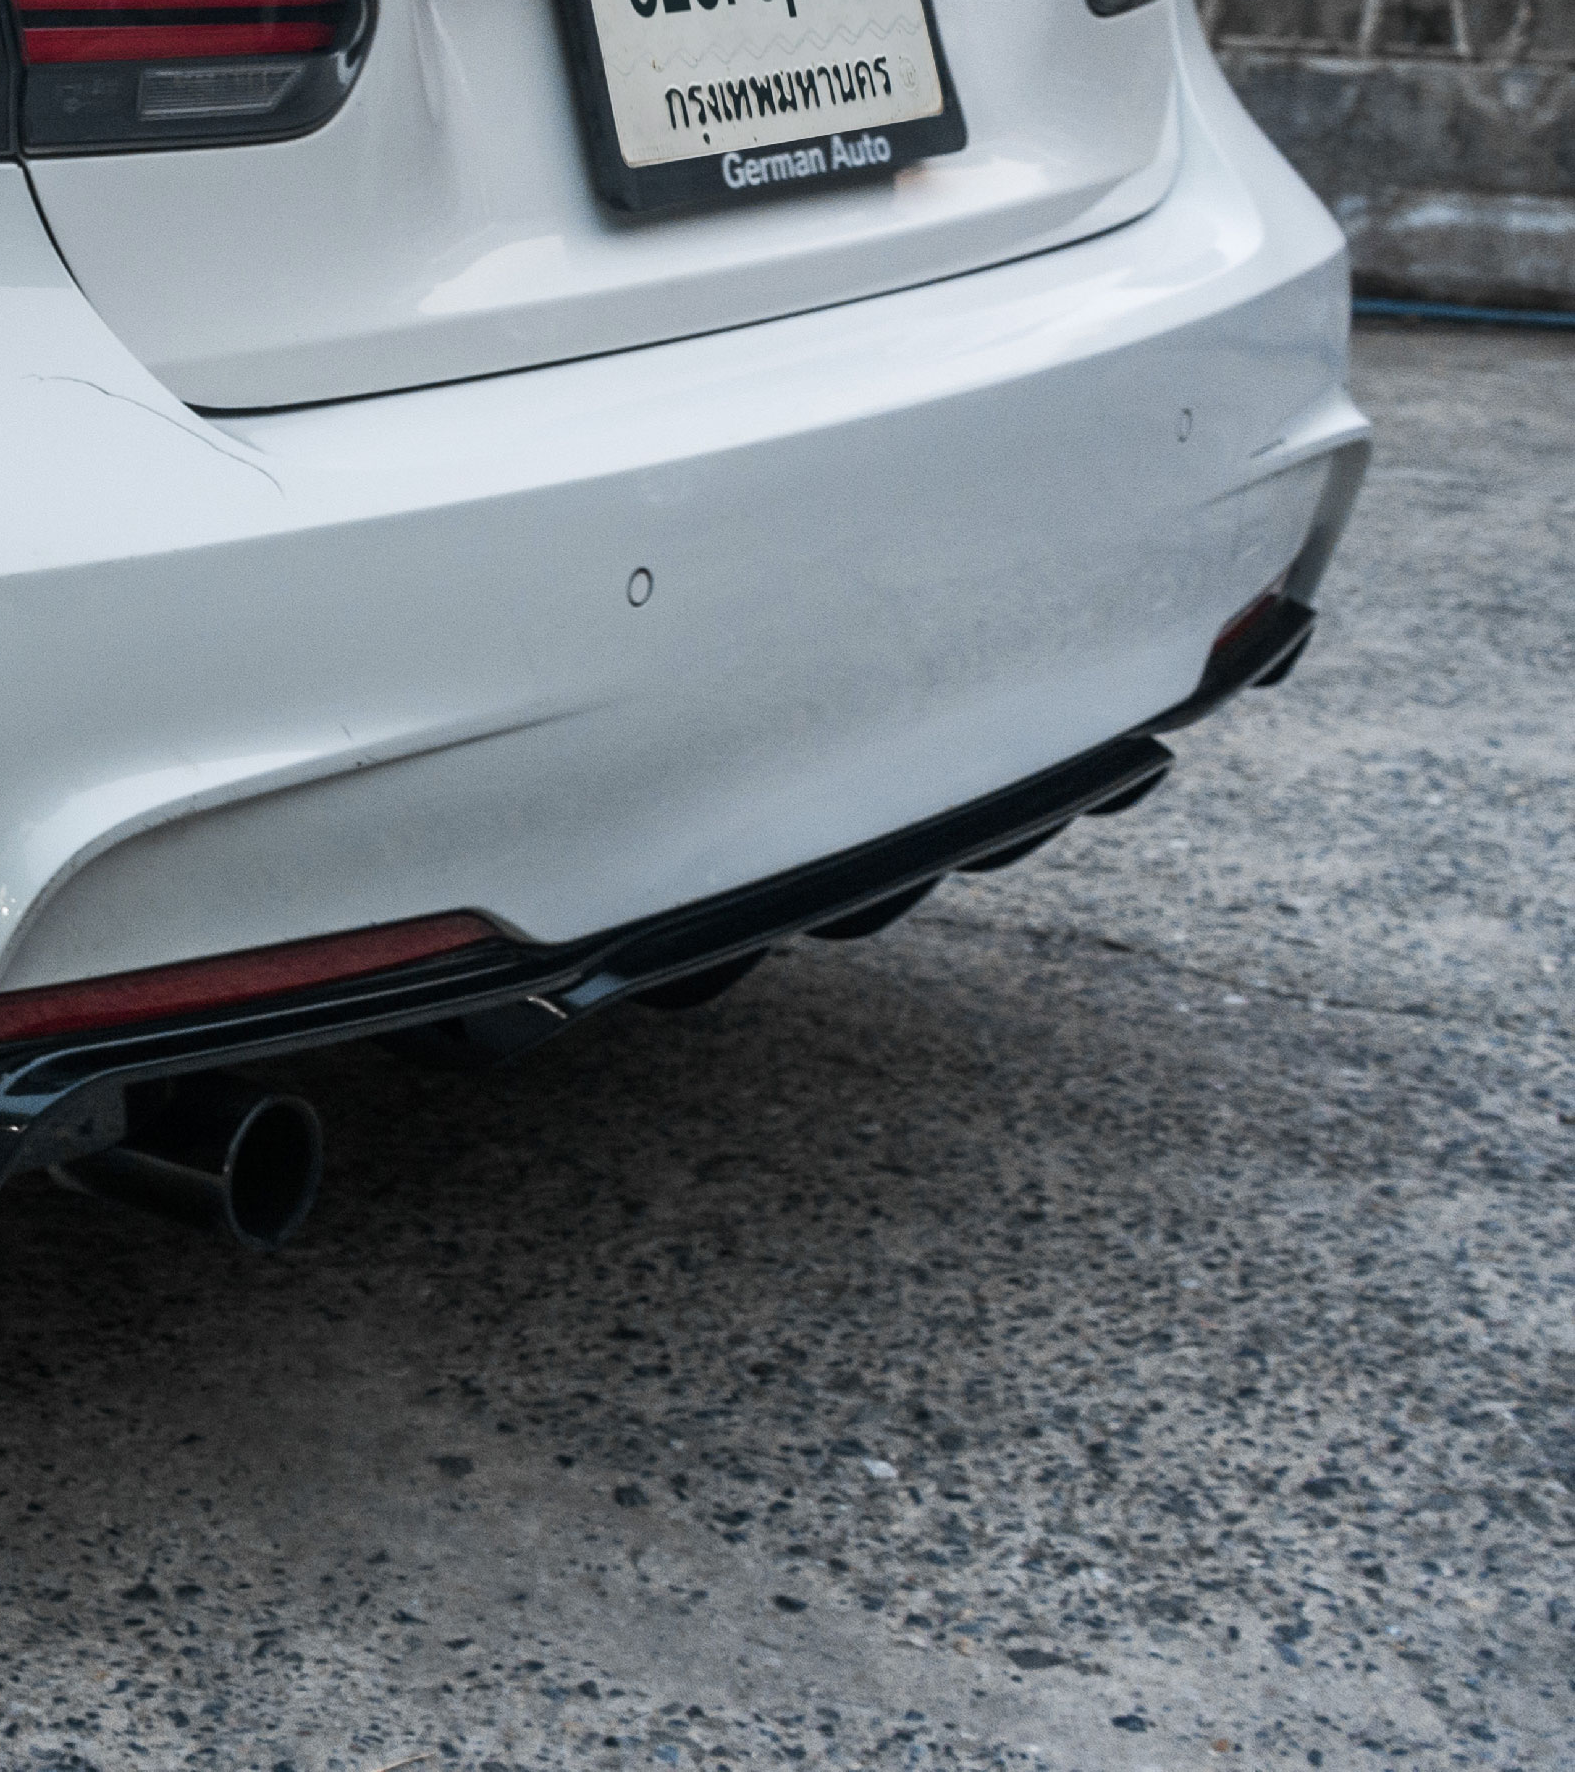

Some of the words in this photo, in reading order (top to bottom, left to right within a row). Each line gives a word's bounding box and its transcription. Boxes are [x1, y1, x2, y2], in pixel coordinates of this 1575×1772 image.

[664, 56, 892, 145] กรุงเทพมหานคร
[721, 150, 828, 190] German
[829, 133, 892, 171] Auto
